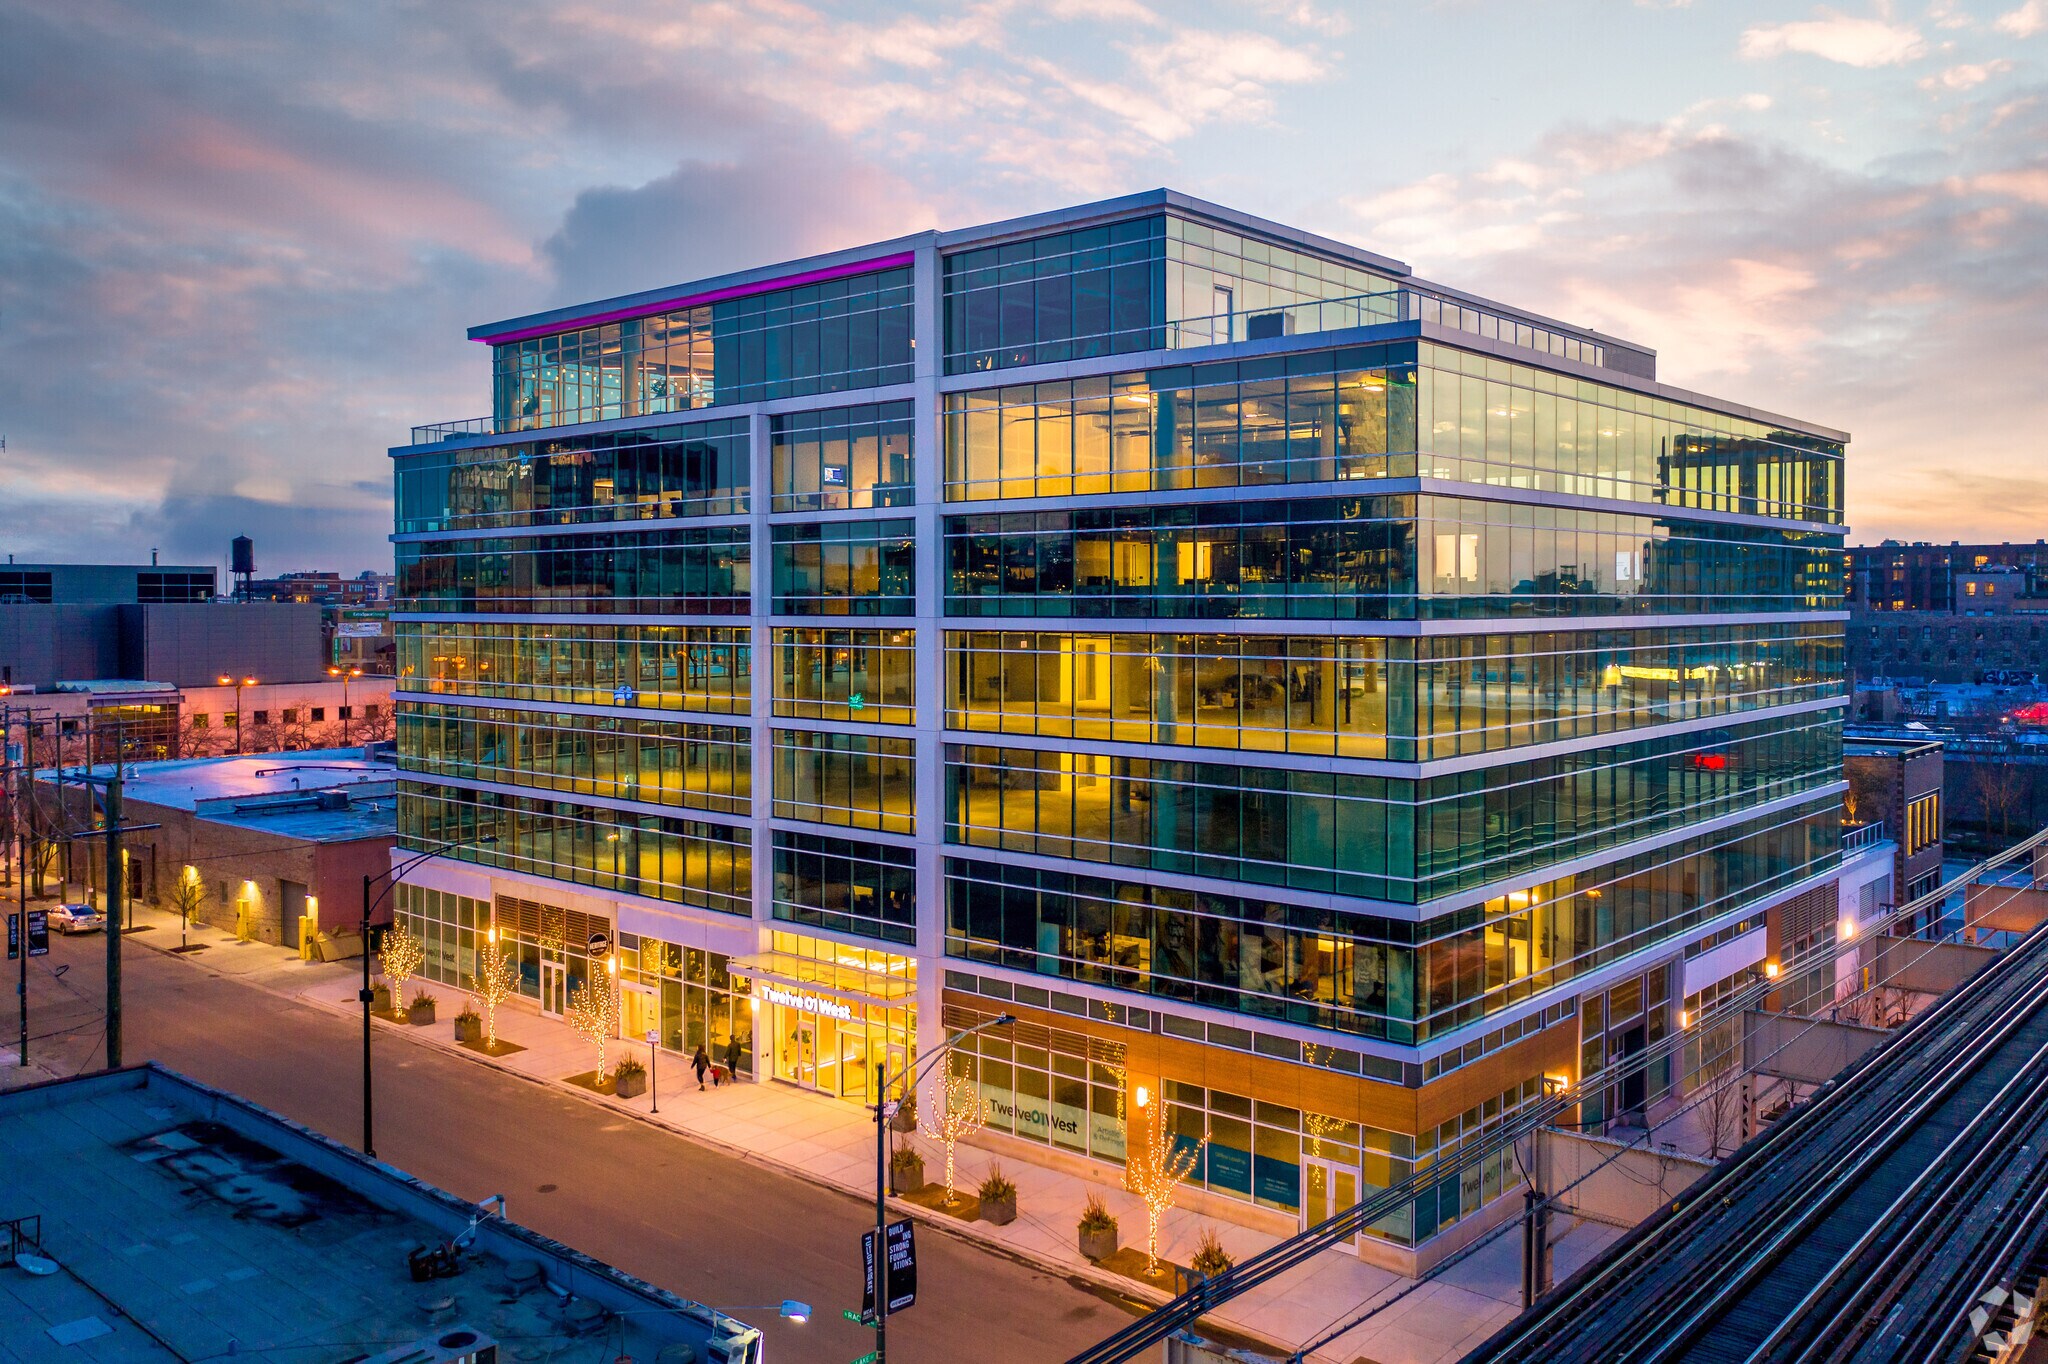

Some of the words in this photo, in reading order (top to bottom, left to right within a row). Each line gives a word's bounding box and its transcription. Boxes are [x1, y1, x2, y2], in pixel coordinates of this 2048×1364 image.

[888, 1223, 904, 1237] BUILD
[902, 1230, 912, 1241] ING
[889, 1240, 910, 1254] STRONG
[889, 1250, 908, 1263] FOUND
